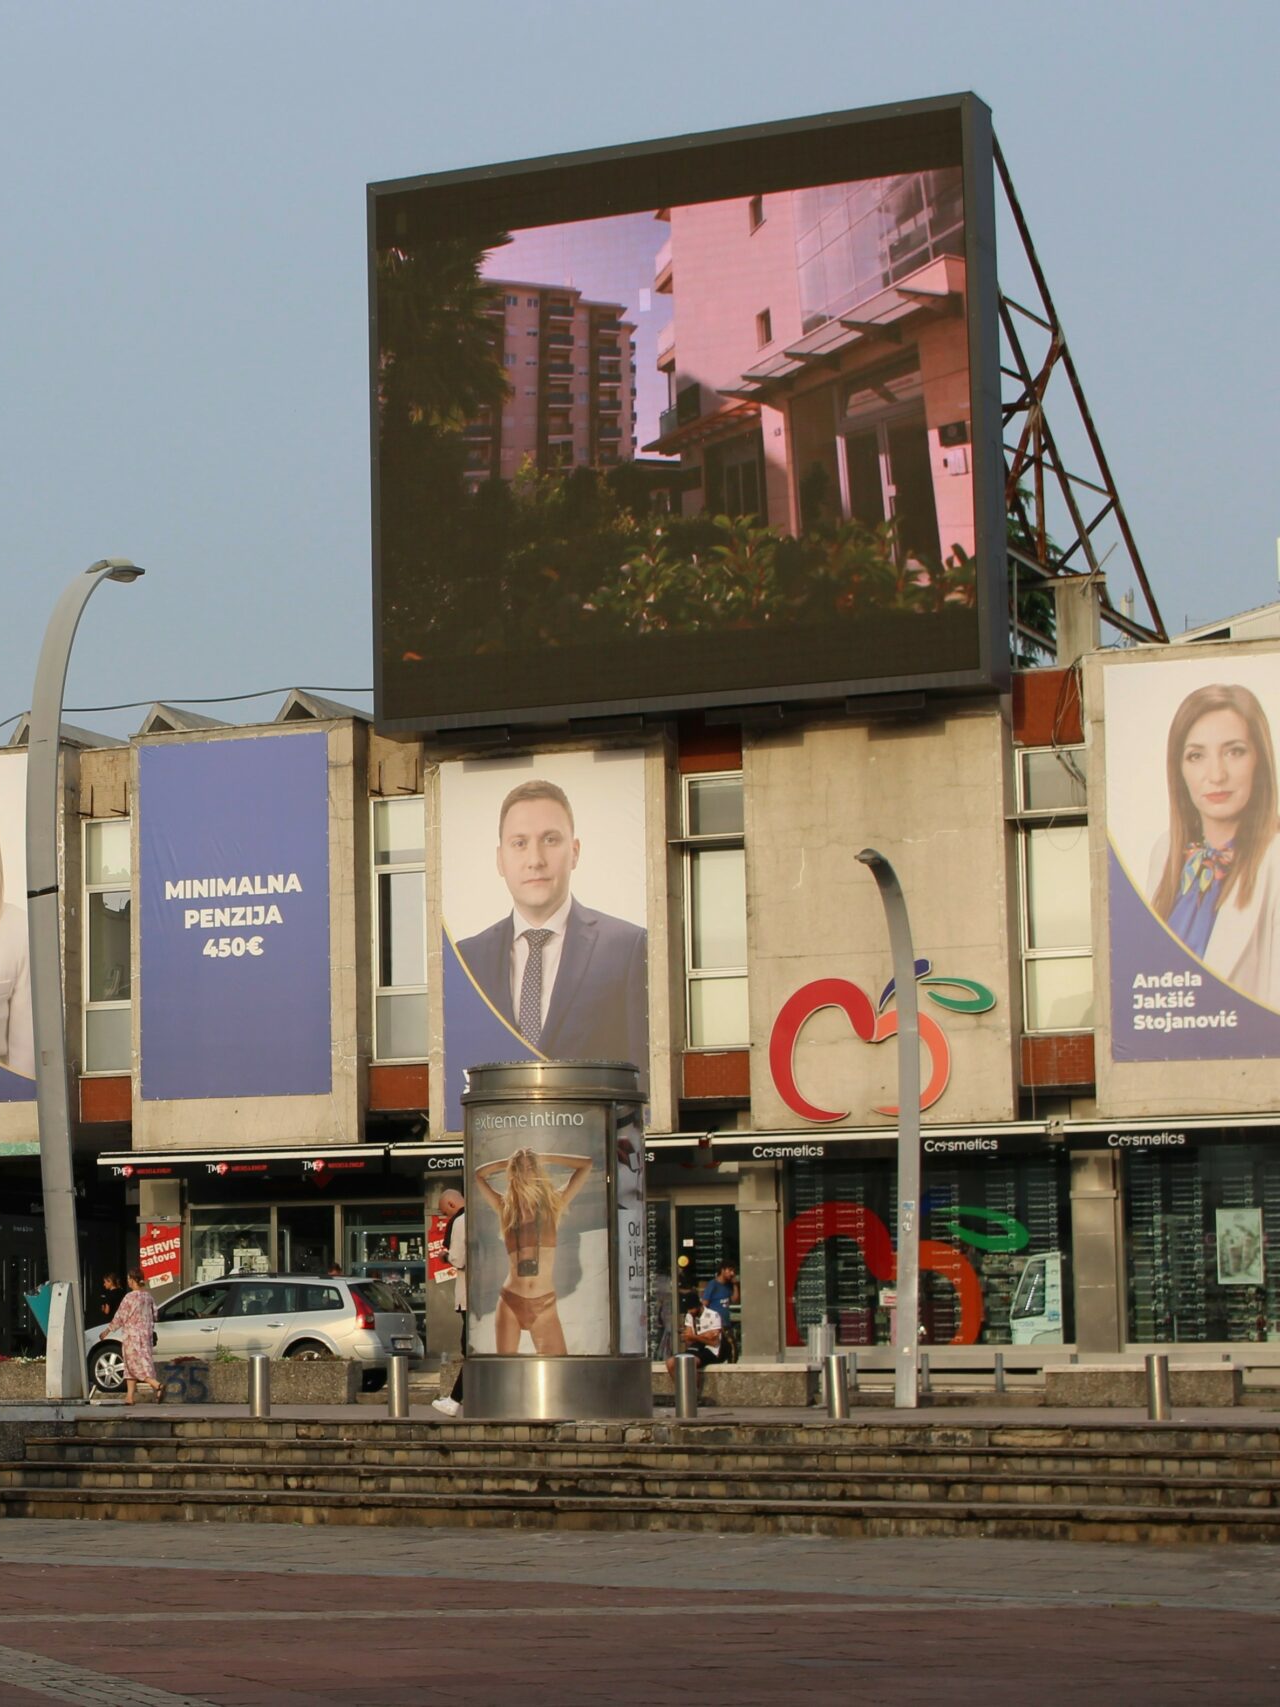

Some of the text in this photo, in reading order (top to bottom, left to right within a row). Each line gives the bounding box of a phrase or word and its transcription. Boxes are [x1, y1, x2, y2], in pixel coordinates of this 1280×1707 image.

[165, 873, 303, 900] MINIMALNA
[184, 904, 283, 929] PENZIJA
[202, 936, 264, 958] 450€
[1132, 971, 1202, 989] Anđela
[1132, 991, 1195, 1009] Jakšić
[1133, 1010, 1238, 1033] Stojanović
[474, 1111, 584, 1130] extreme intimo
[924, 1138, 998, 1152] Cosmetics
[1108, 1133, 1185, 1147] Cosmetics
[752, 1144, 824, 1158] Cosmetics
[427, 1157, 464, 1169] Cosm
[140, 1237, 181, 1258] SERVIS
[141, 1251, 177, 1268] satova
